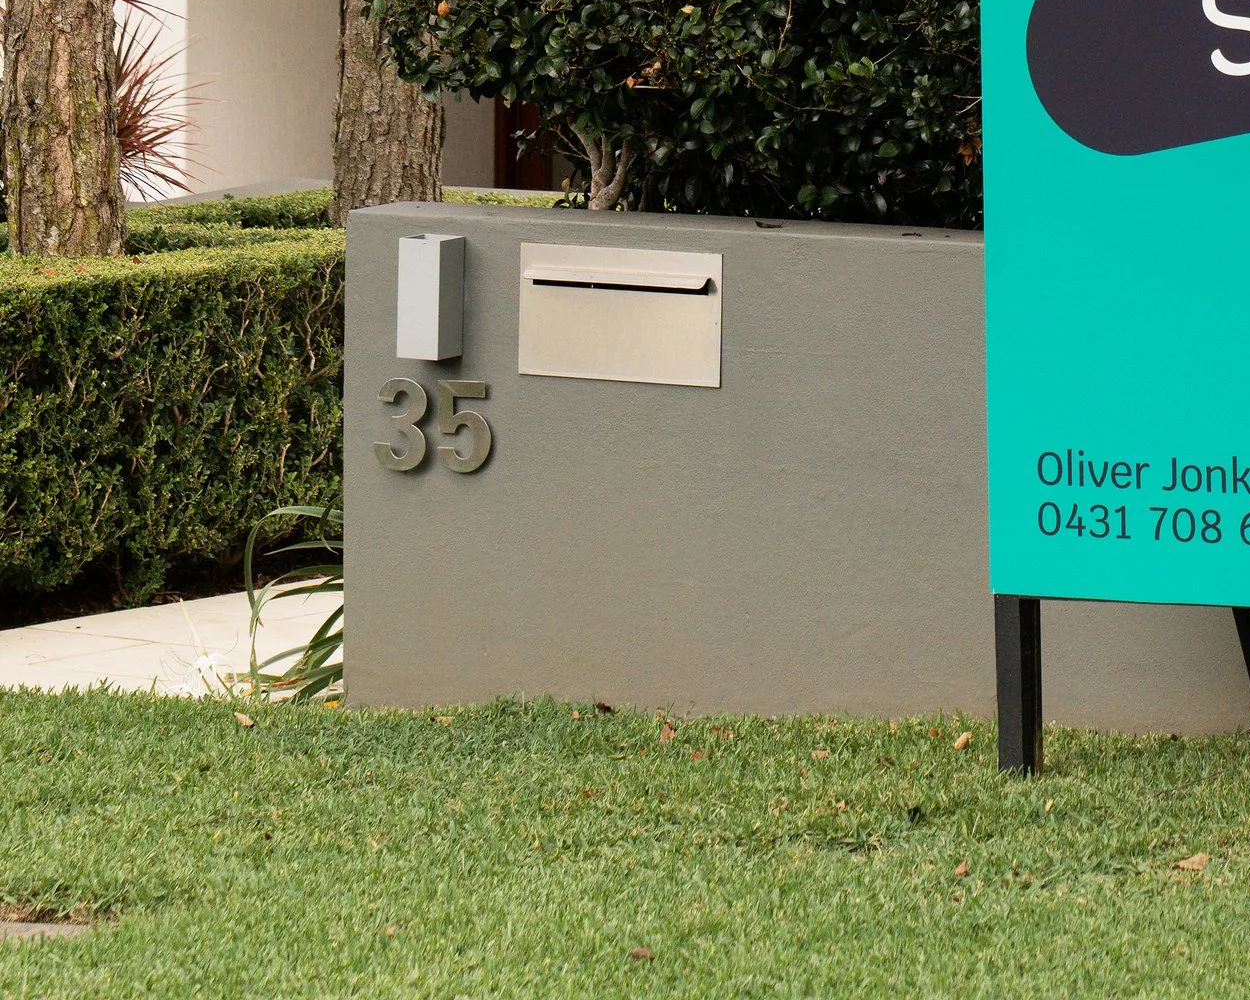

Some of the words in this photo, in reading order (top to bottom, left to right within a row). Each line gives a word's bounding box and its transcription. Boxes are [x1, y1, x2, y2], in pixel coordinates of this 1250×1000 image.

[373, 377, 492, 473] 35
[1037, 448, 1151, 490] Oliver
[1037, 501, 1131, 541] 0431
[1149, 506, 1223, 544] 708
